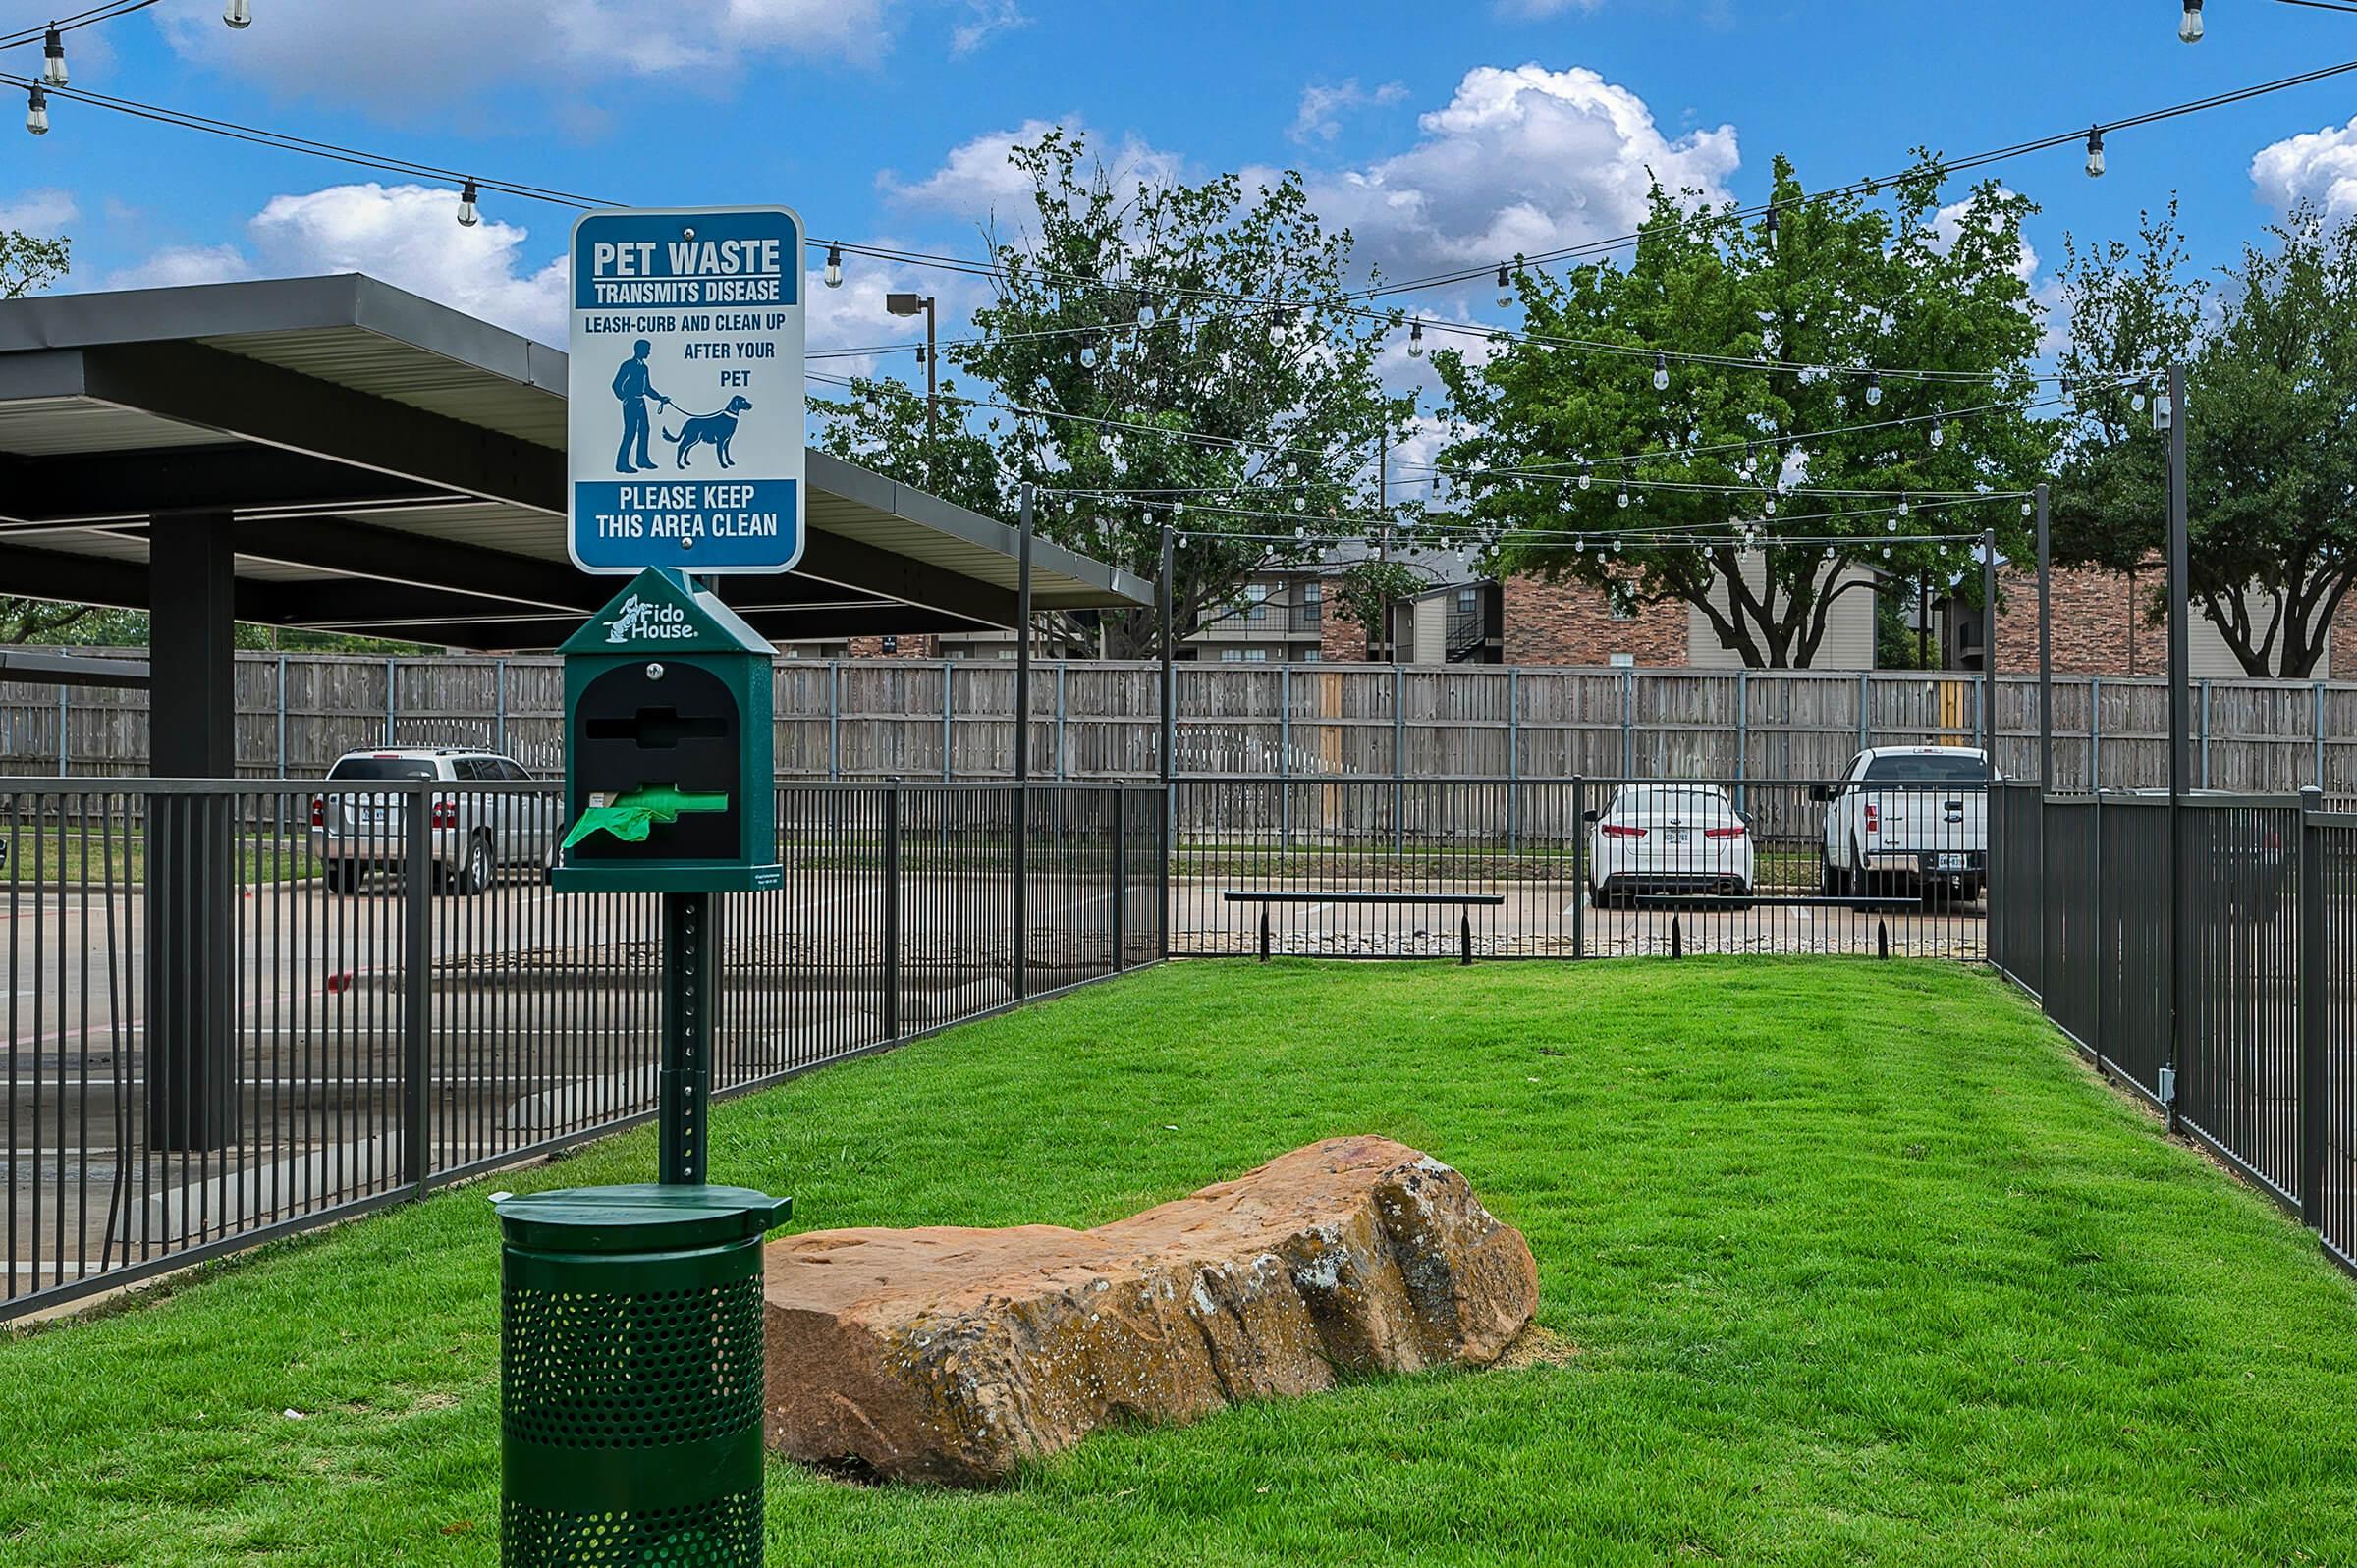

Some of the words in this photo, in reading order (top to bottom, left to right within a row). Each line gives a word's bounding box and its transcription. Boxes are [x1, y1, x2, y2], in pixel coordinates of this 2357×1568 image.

[594, 243, 656, 276] PET
[667, 239, 781, 276] WASTE
[595, 282, 699, 304] TRANSMITS
[705, 280, 780, 302] DISEASE
[585, 315, 676, 333] LEASH-CURB
[681, 315, 710, 331] AND
[715, 314, 761, 331] CLEAN
[766, 313, 786, 330] UP
[684, 343, 731, 359] AFTER
[736, 342, 775, 358] YOUR
[720, 370, 751, 387] PET
[620, 486, 697, 510] PLEASE
[704, 485, 755, 509] KEEP
[595, 514, 644, 538] THIS
[650, 514, 706, 537] AREA
[712, 513, 778, 537] CLEAN
[640, 602, 685, 622] Fido
